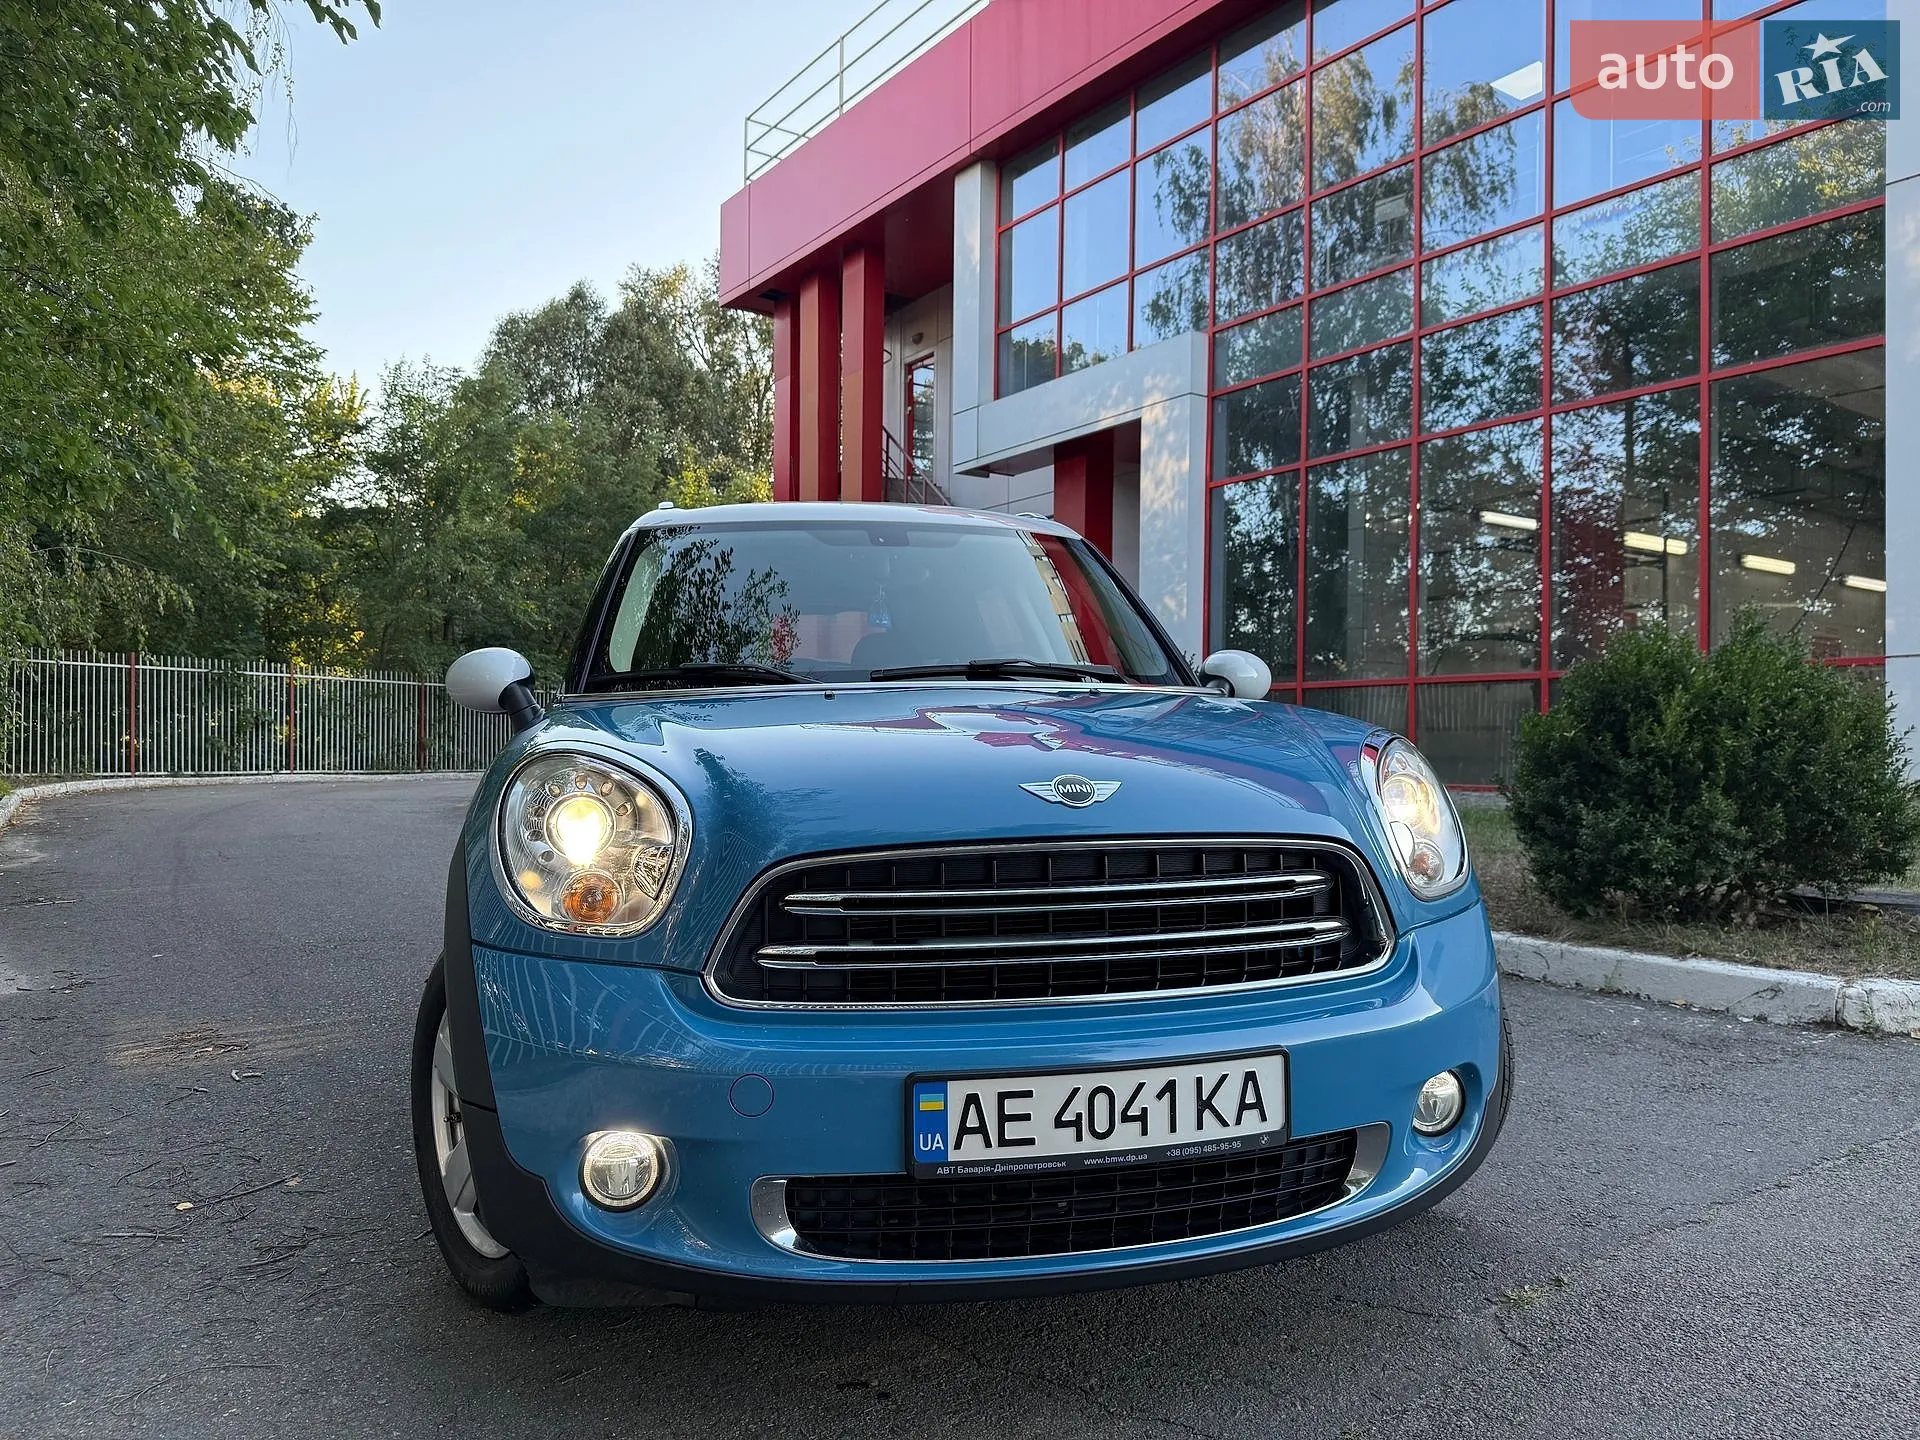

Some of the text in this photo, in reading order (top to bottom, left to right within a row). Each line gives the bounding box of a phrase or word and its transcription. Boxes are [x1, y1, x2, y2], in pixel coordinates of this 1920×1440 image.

[1057, 783, 1092, 794] MINI
[953, 1069, 1268, 1151] AE 4041 KA
[919, 1132, 945, 1151] UA
[1166, 1141, 1242, 1157] +38 (095) 485-95-95
[1084, 1152, 1148, 1166] www.bmw.dp.ua
[936, 1166, 956, 1175] АВТ
